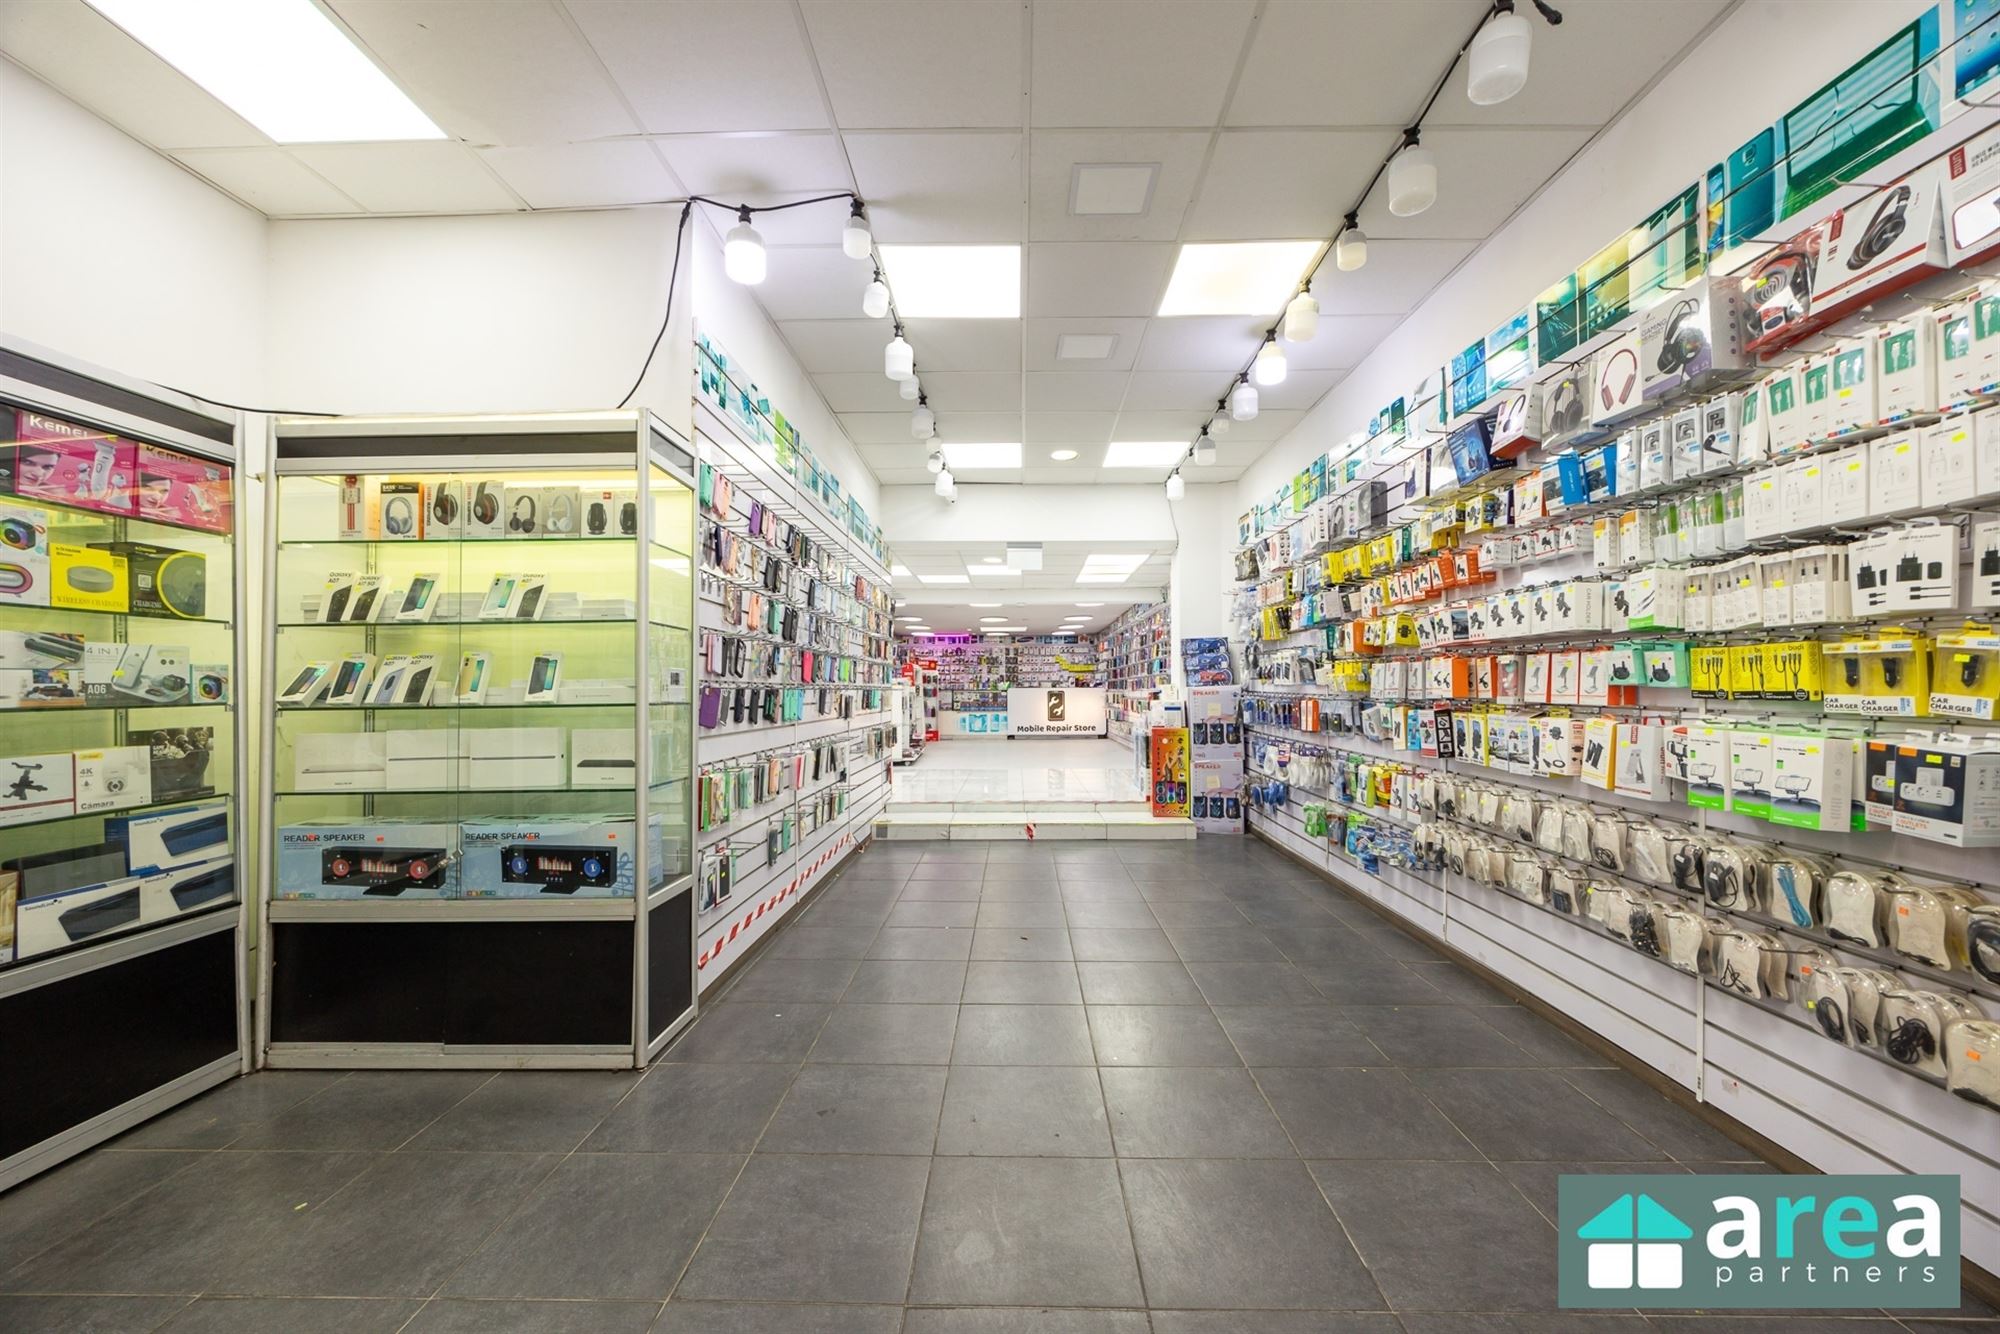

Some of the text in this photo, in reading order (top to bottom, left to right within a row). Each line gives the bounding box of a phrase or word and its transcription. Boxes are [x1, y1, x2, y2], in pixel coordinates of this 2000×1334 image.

[87, 684, 107, 695] A06
[1930, 703, 1973, 713] CHARGER
[1017, 724, 1097, 733] Mobile Repair Store
[79, 767, 93, 775] 4K
[283, 833, 366, 843] READER SPEAKER
[465, 831, 541, 841] READER SPEAKER
